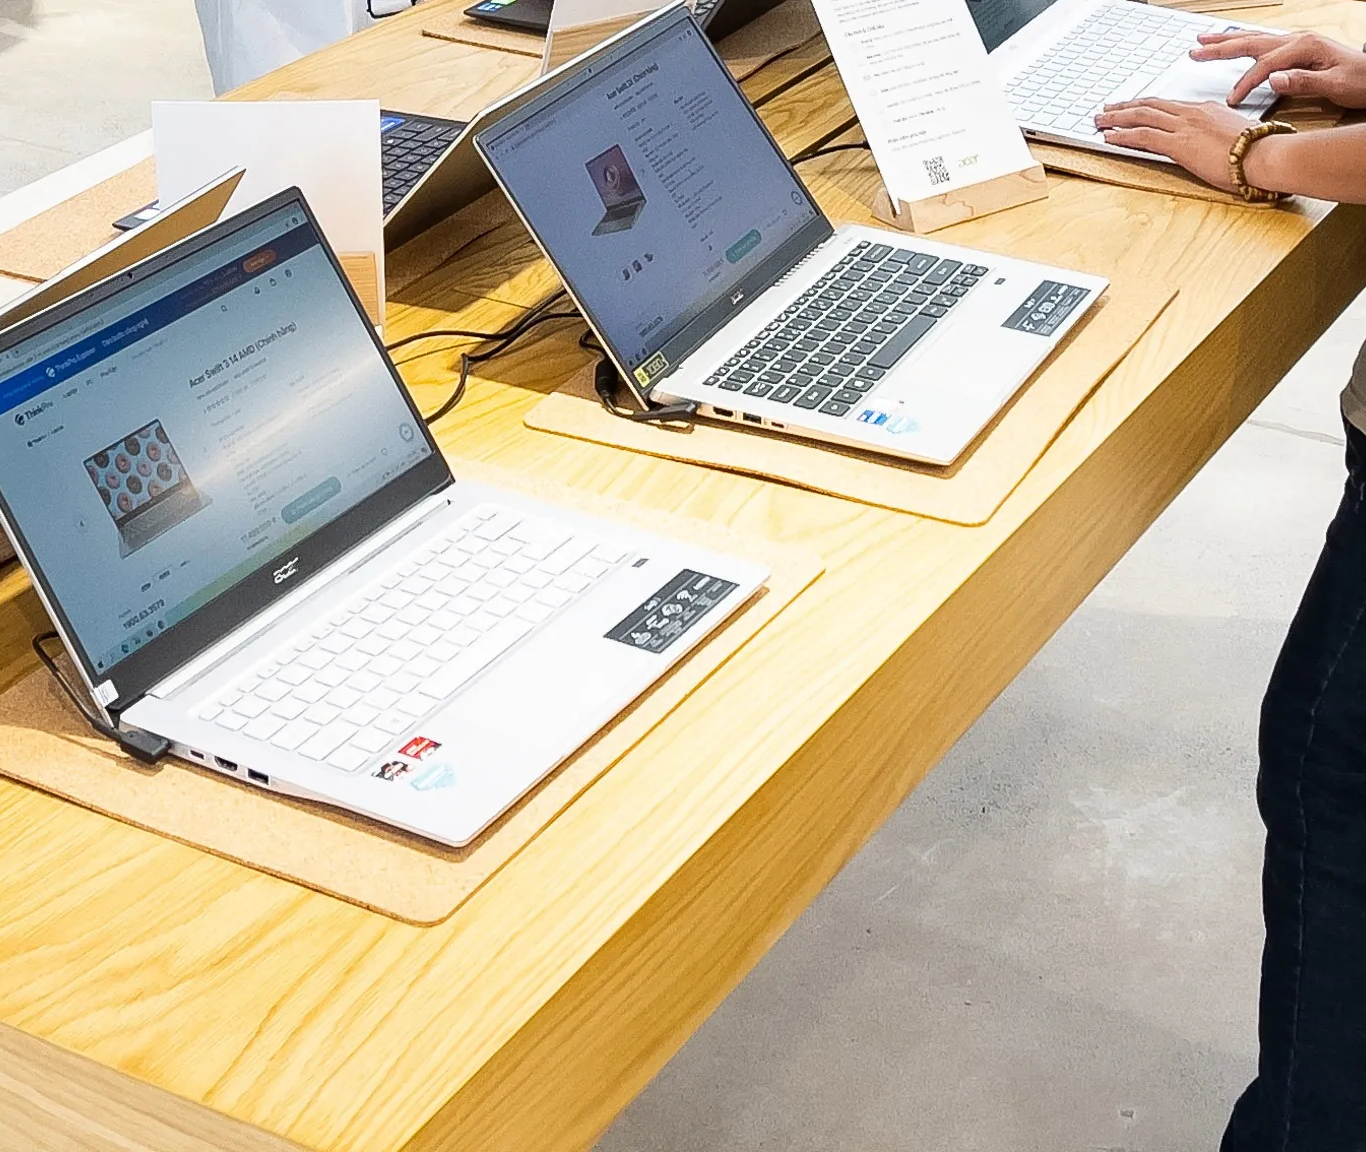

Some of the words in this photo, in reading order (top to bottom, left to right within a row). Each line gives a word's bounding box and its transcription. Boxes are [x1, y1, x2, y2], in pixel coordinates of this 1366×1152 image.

[958, 154, 979, 168] acer
[189, 374, 205, 389] Acer
[238, 344, 256, 360] AMD
[24, 400, 54, 421] ThinkPro
